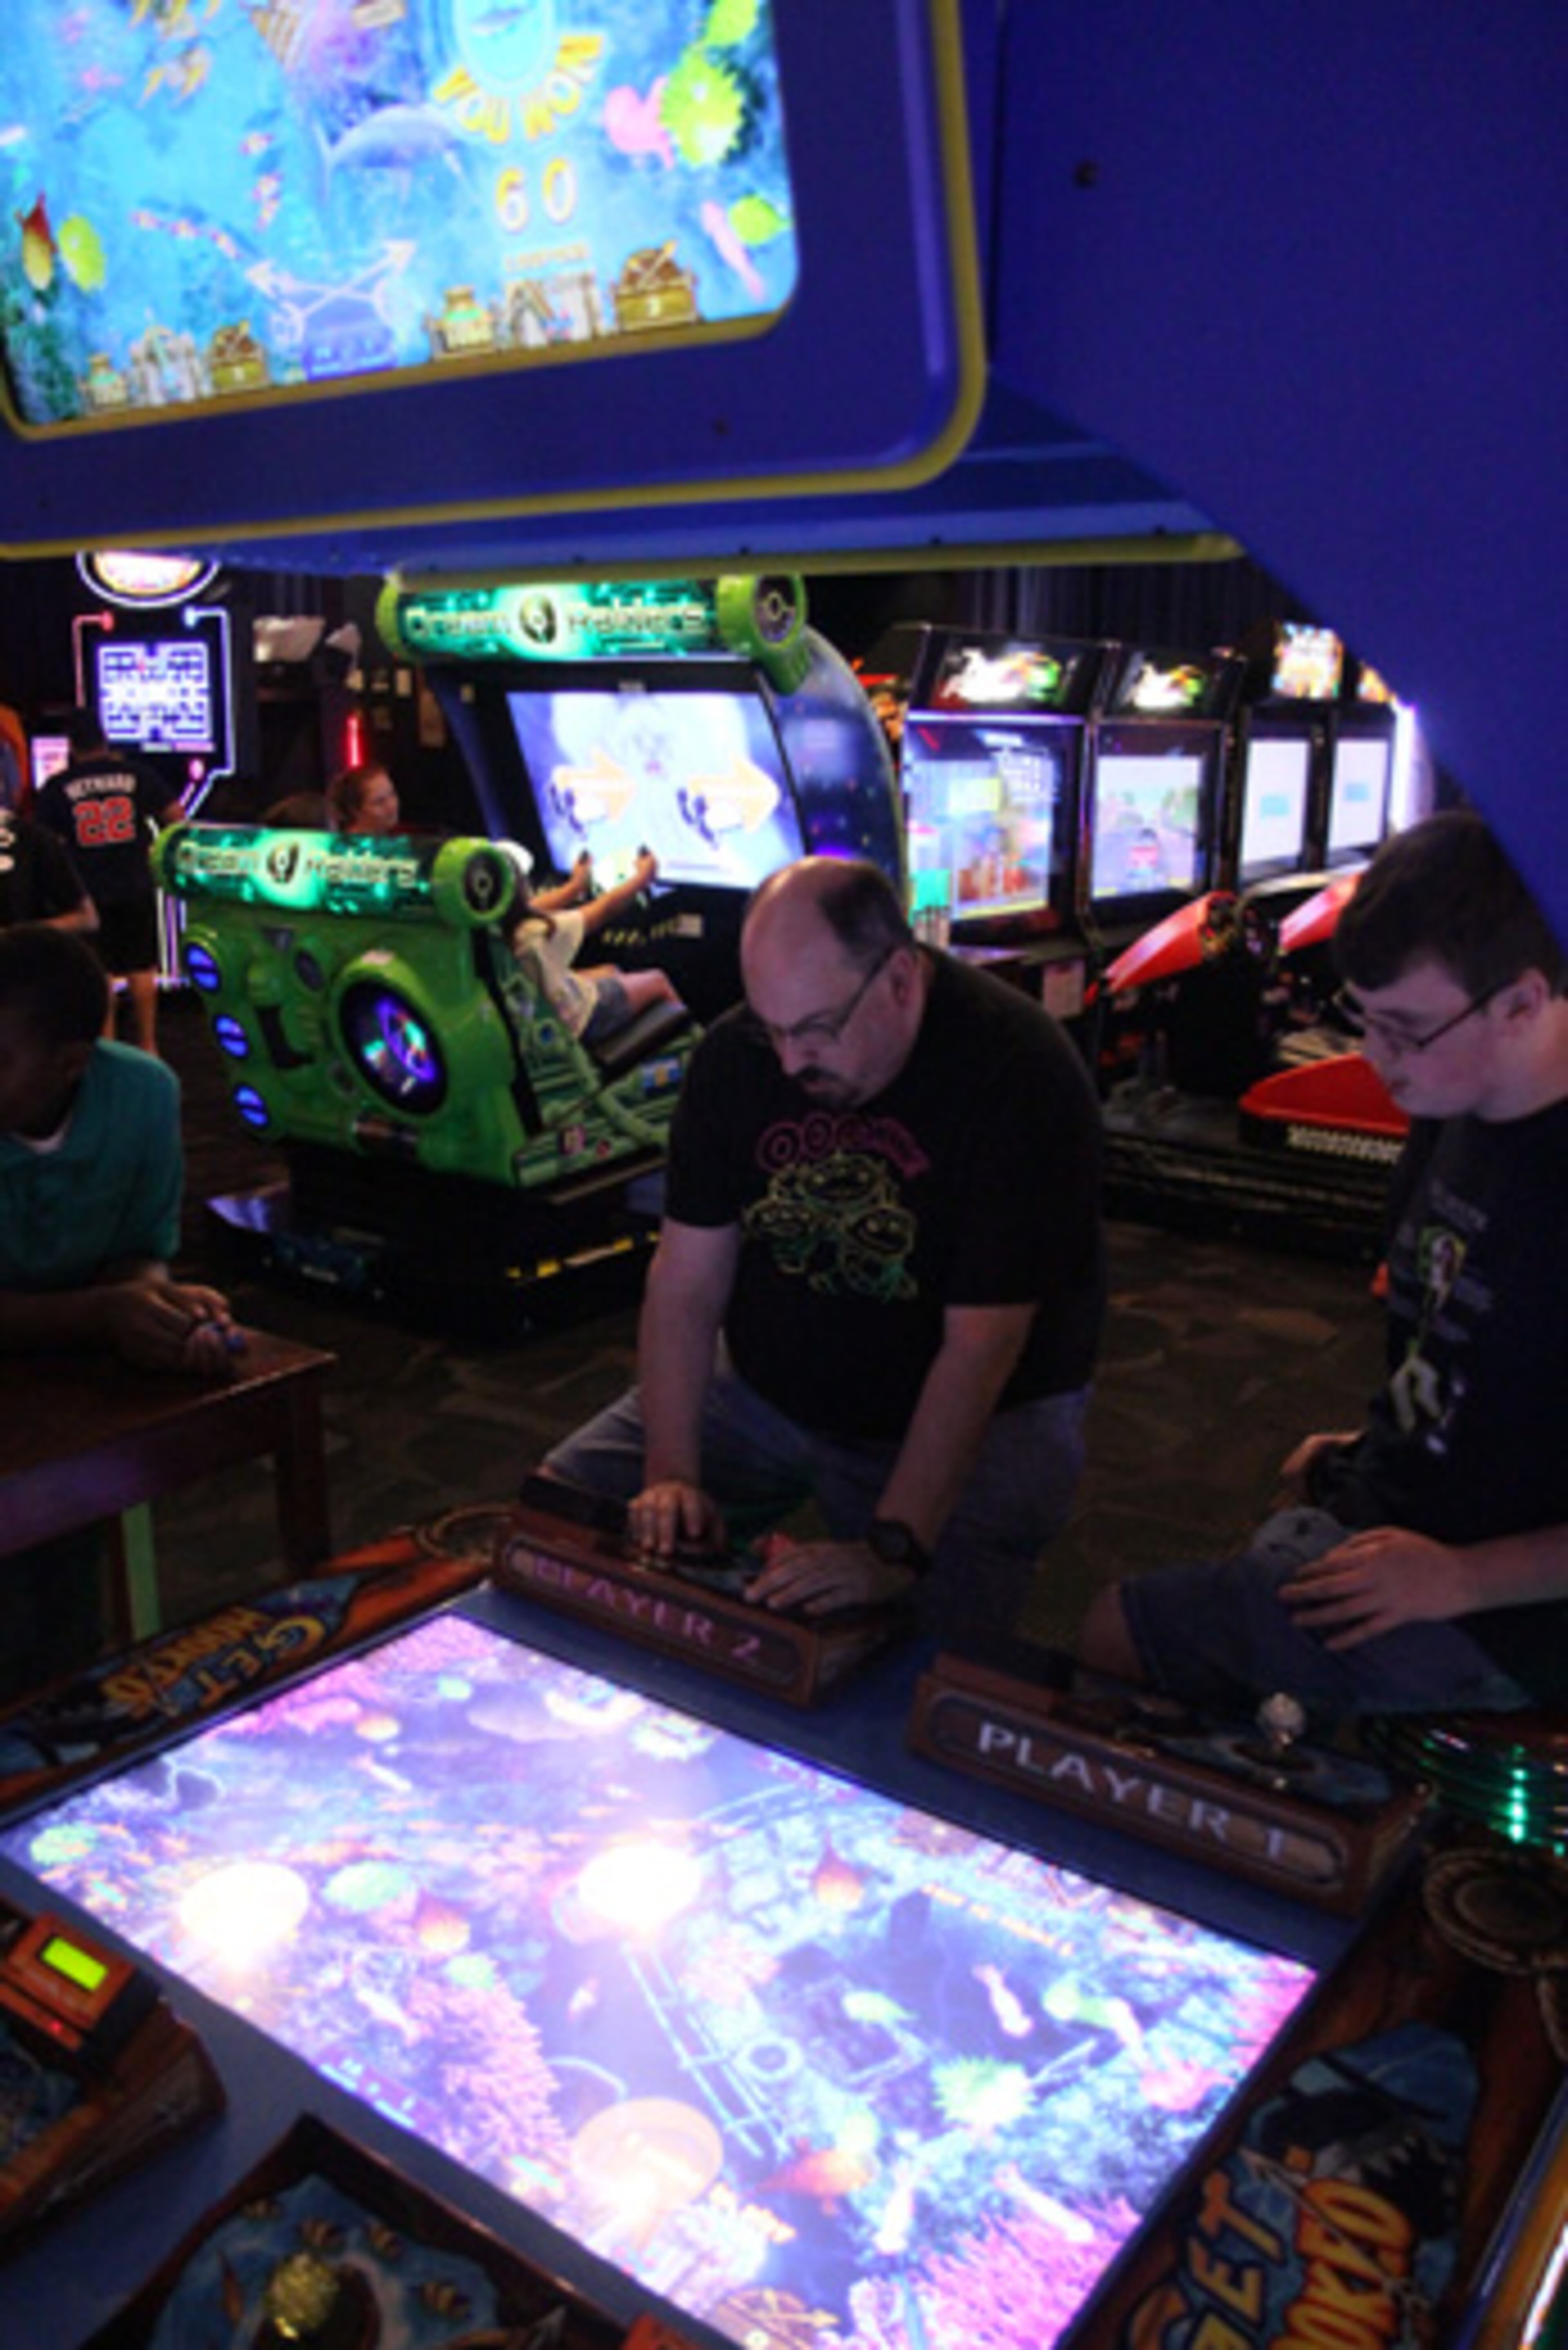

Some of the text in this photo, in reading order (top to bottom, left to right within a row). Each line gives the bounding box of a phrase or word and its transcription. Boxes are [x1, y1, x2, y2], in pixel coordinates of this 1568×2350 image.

[494, 158, 577, 234] 60
[73, 796, 135, 846] 22
[532, 1555, 763, 1665] PLAYER 2
[198, 1615, 326, 1710] GET
[978, 1719, 1286, 1861] PLAYER 1
